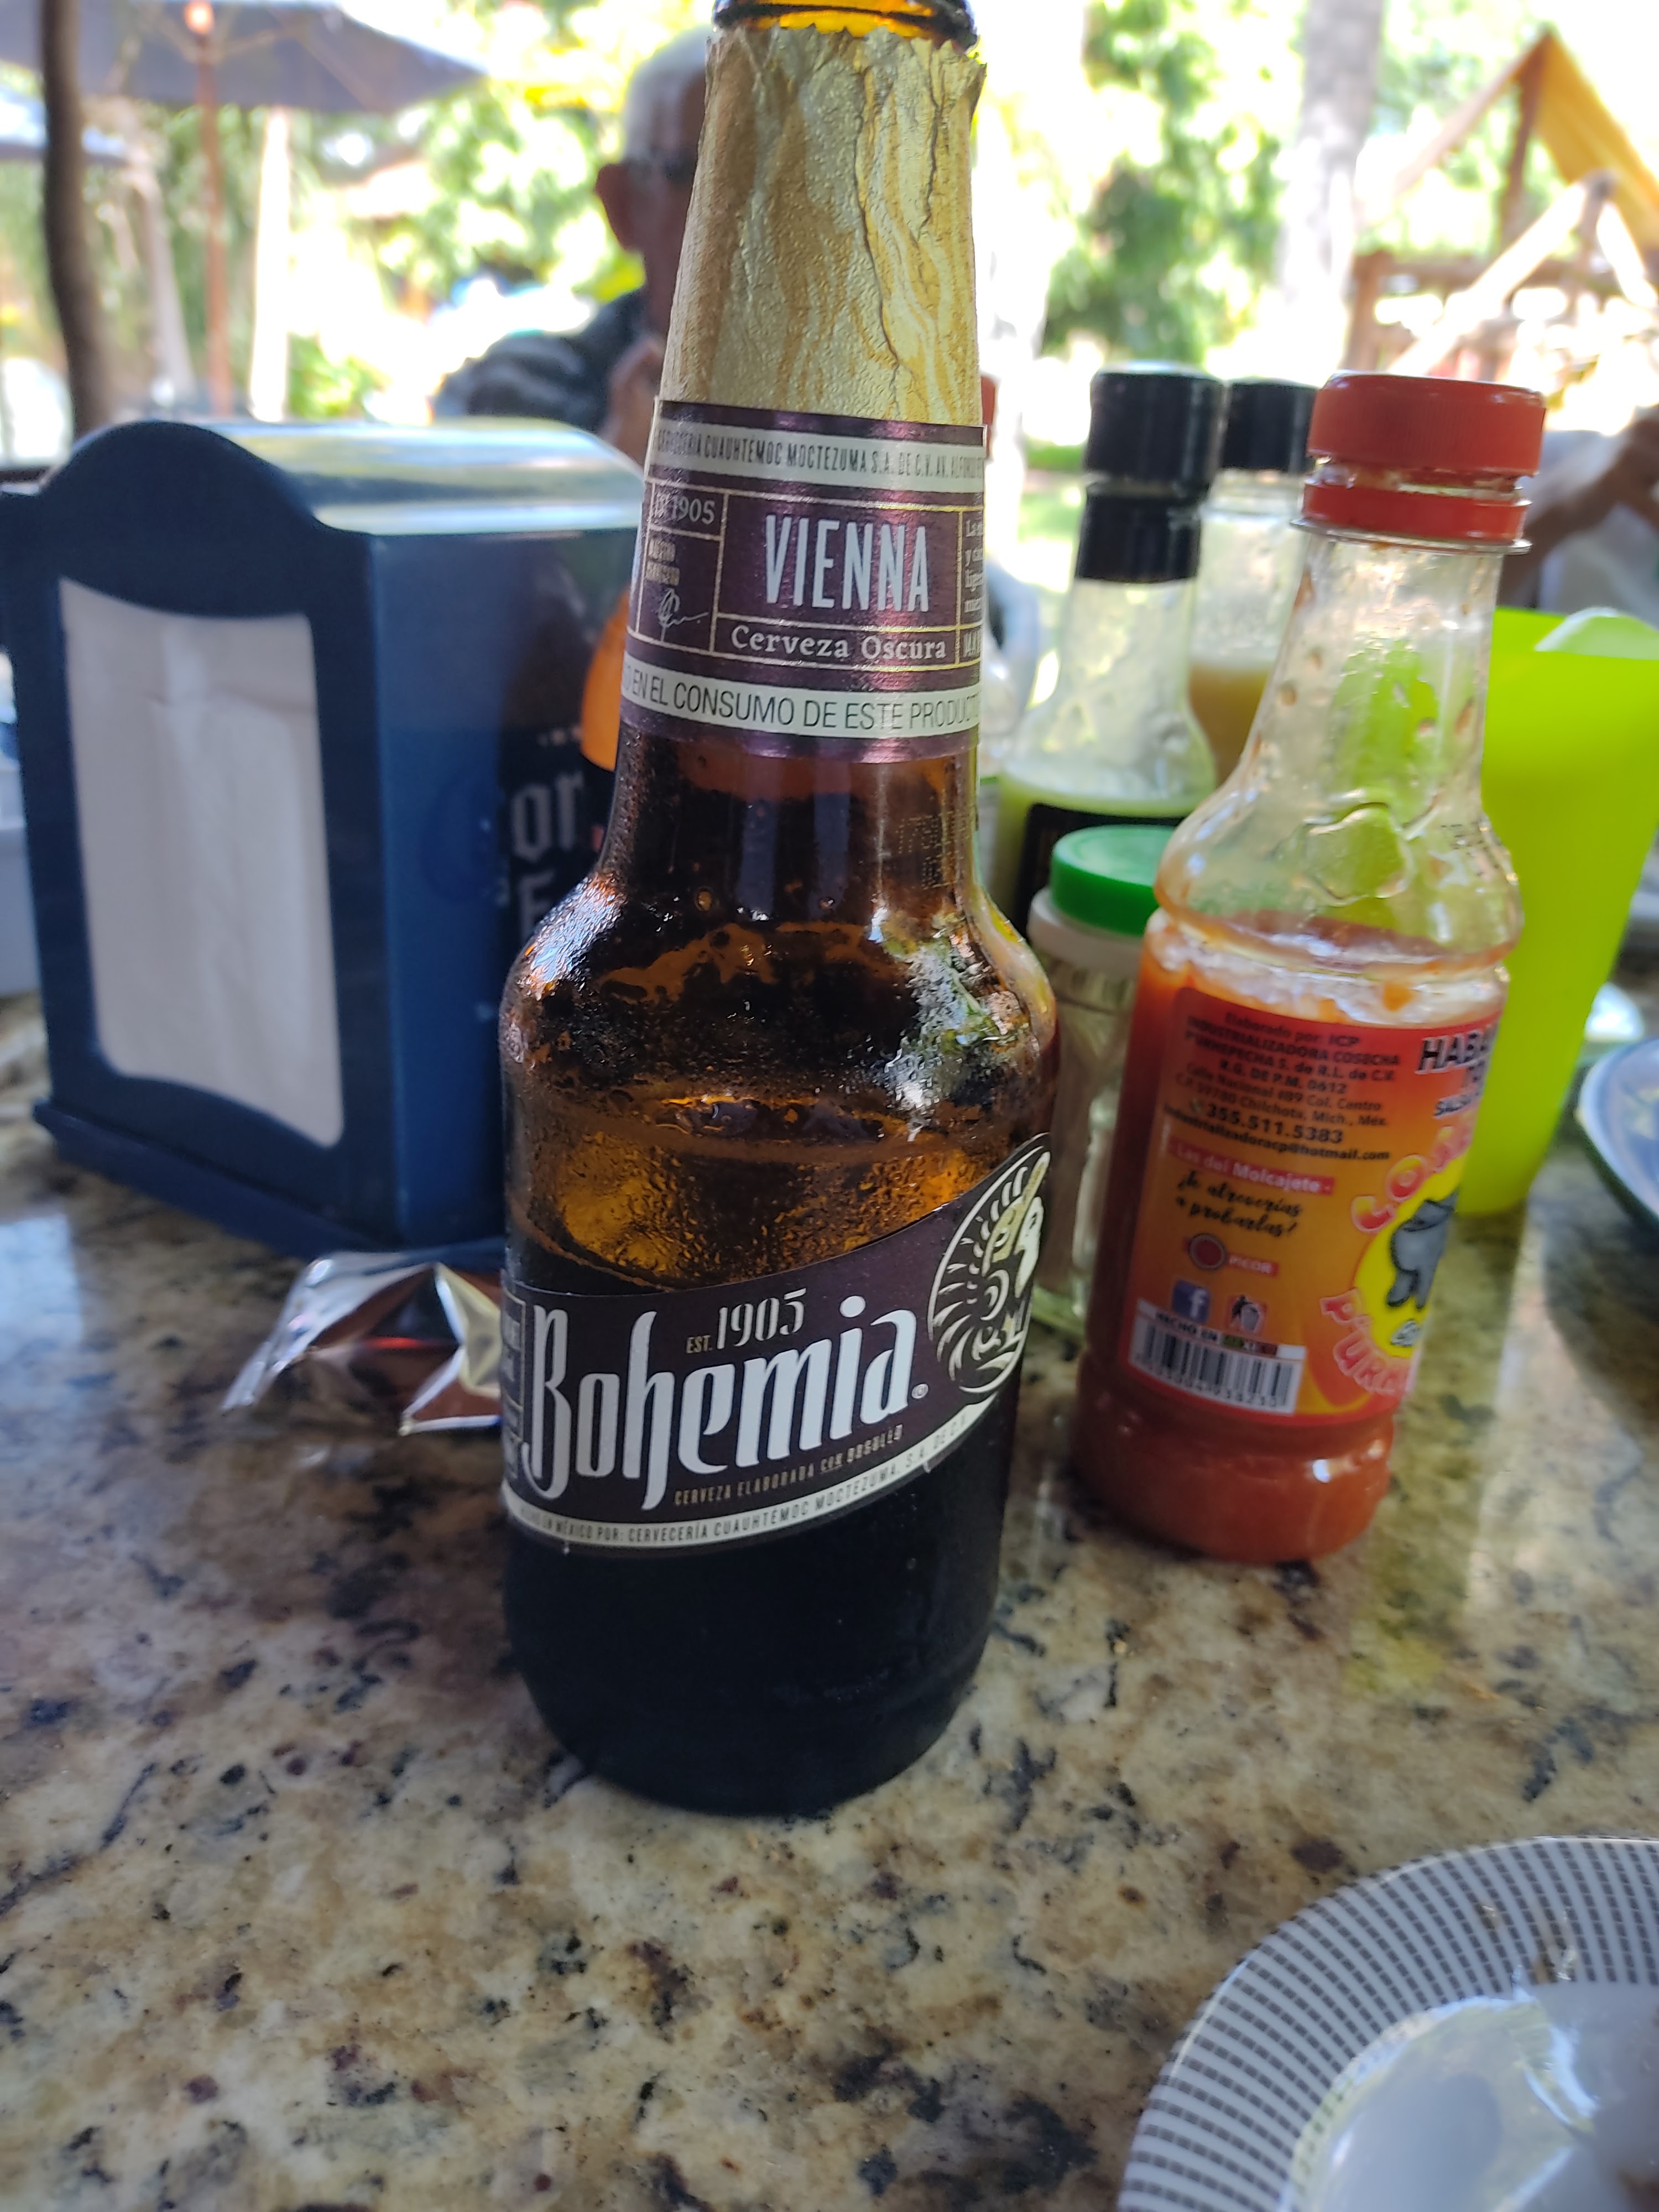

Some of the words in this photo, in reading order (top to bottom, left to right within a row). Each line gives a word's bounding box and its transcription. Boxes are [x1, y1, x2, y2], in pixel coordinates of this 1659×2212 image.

[786, 442, 867, 473] MOCTEZUMA
[898, 452, 911, 476] DE
[765, 515, 930, 612] VIENNA
[731, 625, 850, 659] Cerveza
[861, 635, 947, 660] Oscura
[632, 670, 648, 700] EN
[650, 676, 668, 706] EL
[674, 682, 795, 726] CONSUMO
[803, 700, 837, 727] DE
[845, 702, 904, 730] ESTE
[1207, 1103, 1344, 1144] 355.511.5383
[1233, 1161, 1322, 1193] Molcajete
[686, 1334, 713, 1354] EST.
[717, 1287, 807, 1350] 1905
[521, 1296, 918, 1511] Bohemia
[674, 1483, 732, 1507] CERVEZA
[737, 1462, 815, 1498] ELABORADA
[628, 1521, 708, 1542] CERVECERÍA
[713, 1499, 809, 1537] CUAUHTÉMOC
